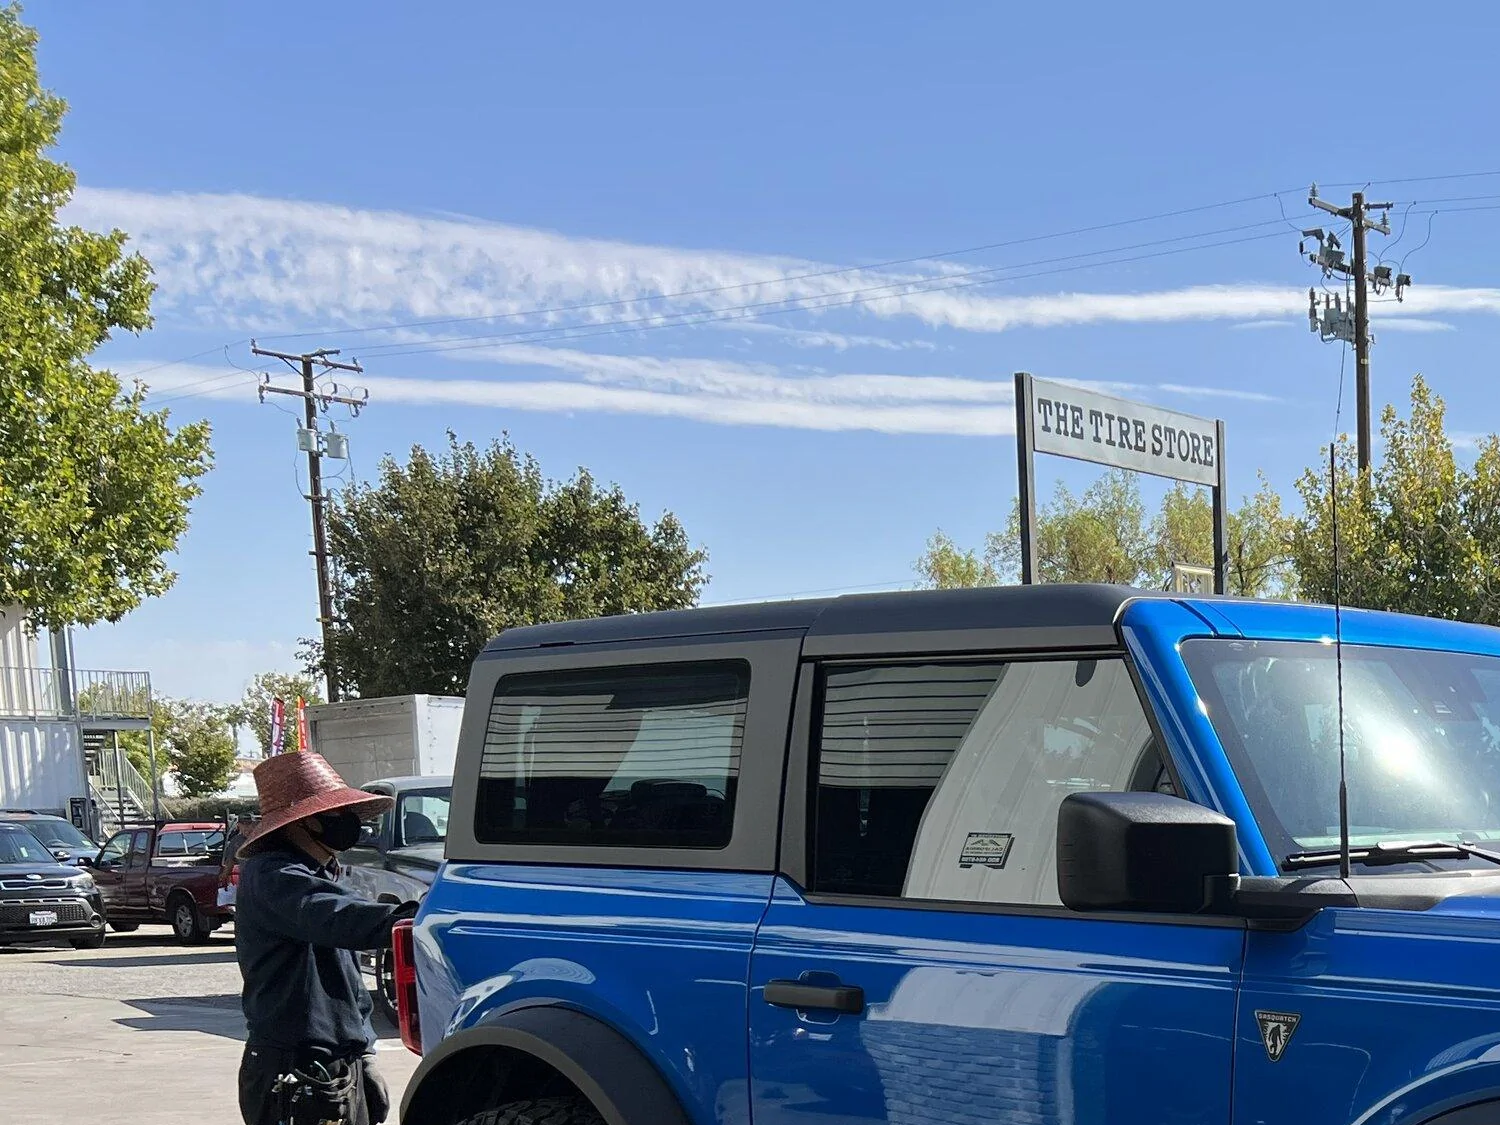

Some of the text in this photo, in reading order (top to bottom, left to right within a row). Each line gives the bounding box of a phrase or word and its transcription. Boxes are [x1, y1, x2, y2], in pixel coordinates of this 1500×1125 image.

[1037, 398, 1214, 467] THE TIRE STORE
[1258, 1013, 1297, 1023] SASQUATCH
